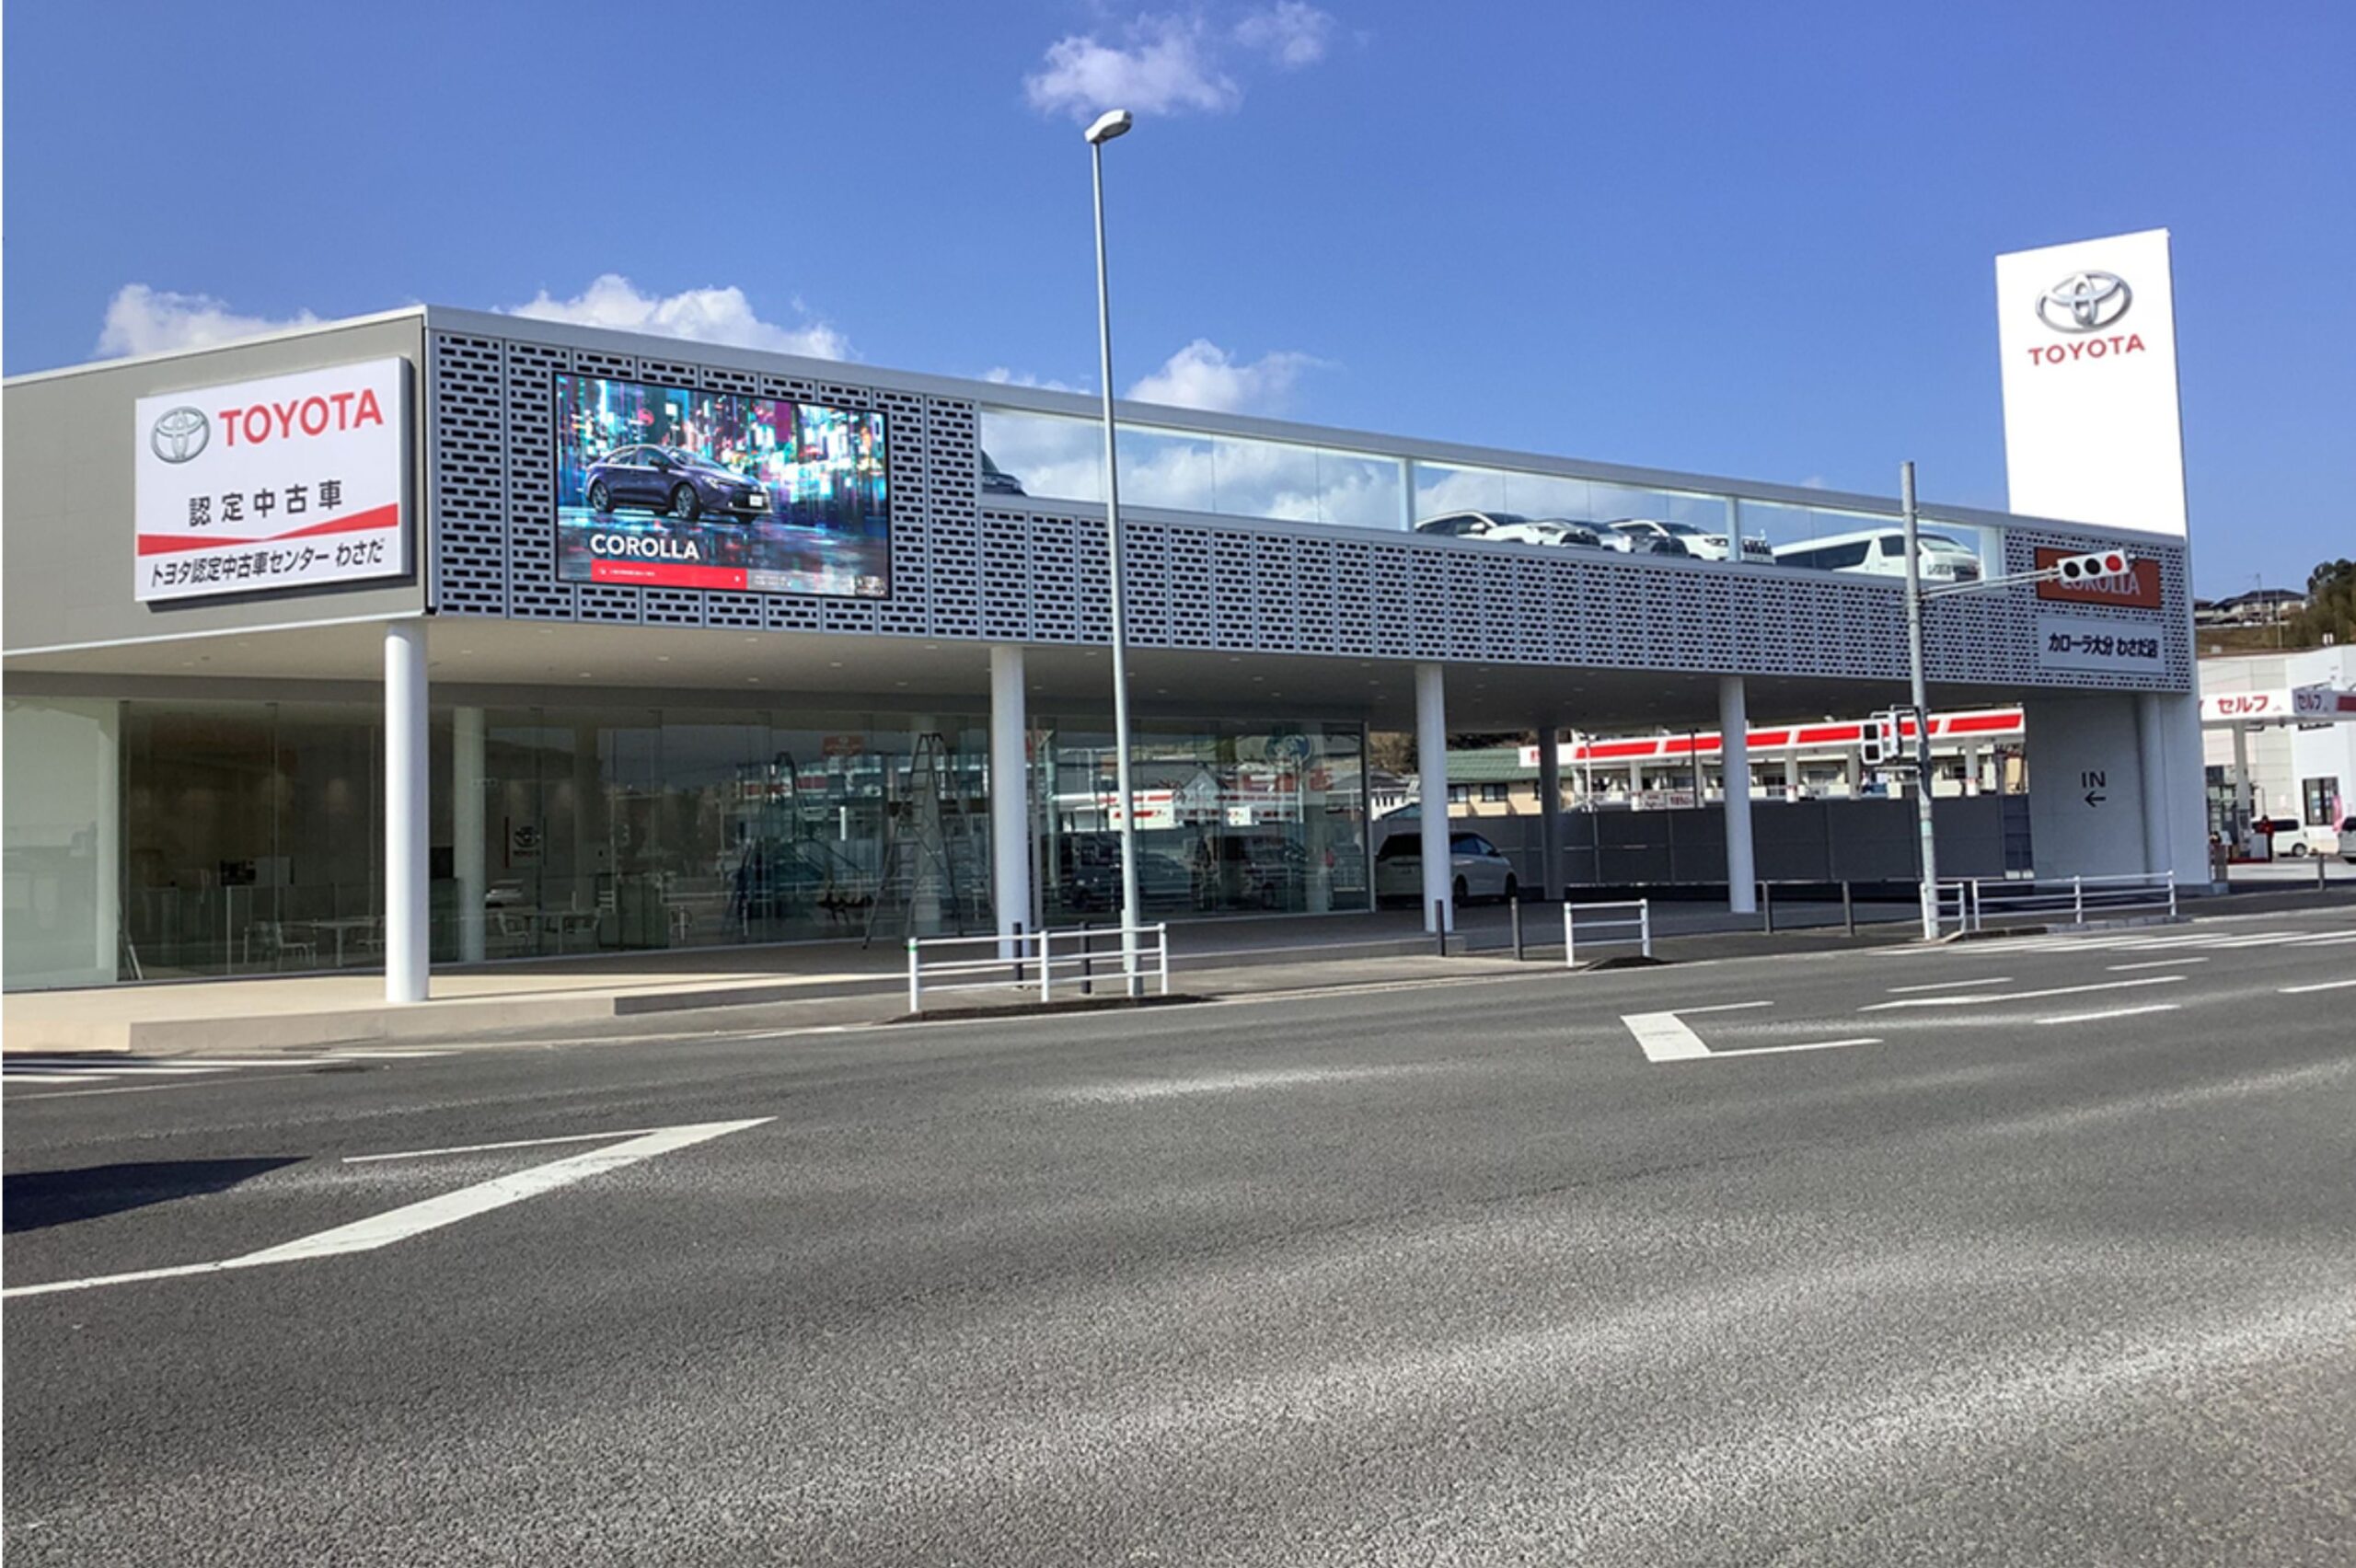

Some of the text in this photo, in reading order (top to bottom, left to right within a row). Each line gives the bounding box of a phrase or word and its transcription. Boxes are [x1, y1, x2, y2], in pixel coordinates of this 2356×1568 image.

[2028, 333, 2145, 366] TOYOTA
[218, 388, 384, 447] TOYOTA
[189, 479, 341, 527] 認定中古車
[590, 534, 700, 560] COROLLA
[151, 537, 386, 588] トヨタ認定中古車センター わさだ
[2058, 569, 2141, 596] OLLA
[2049, 632, 2114, 656] カローラ大分
[2217, 695, 2269, 714] セルフ
[2081, 771, 2106, 788] IN
